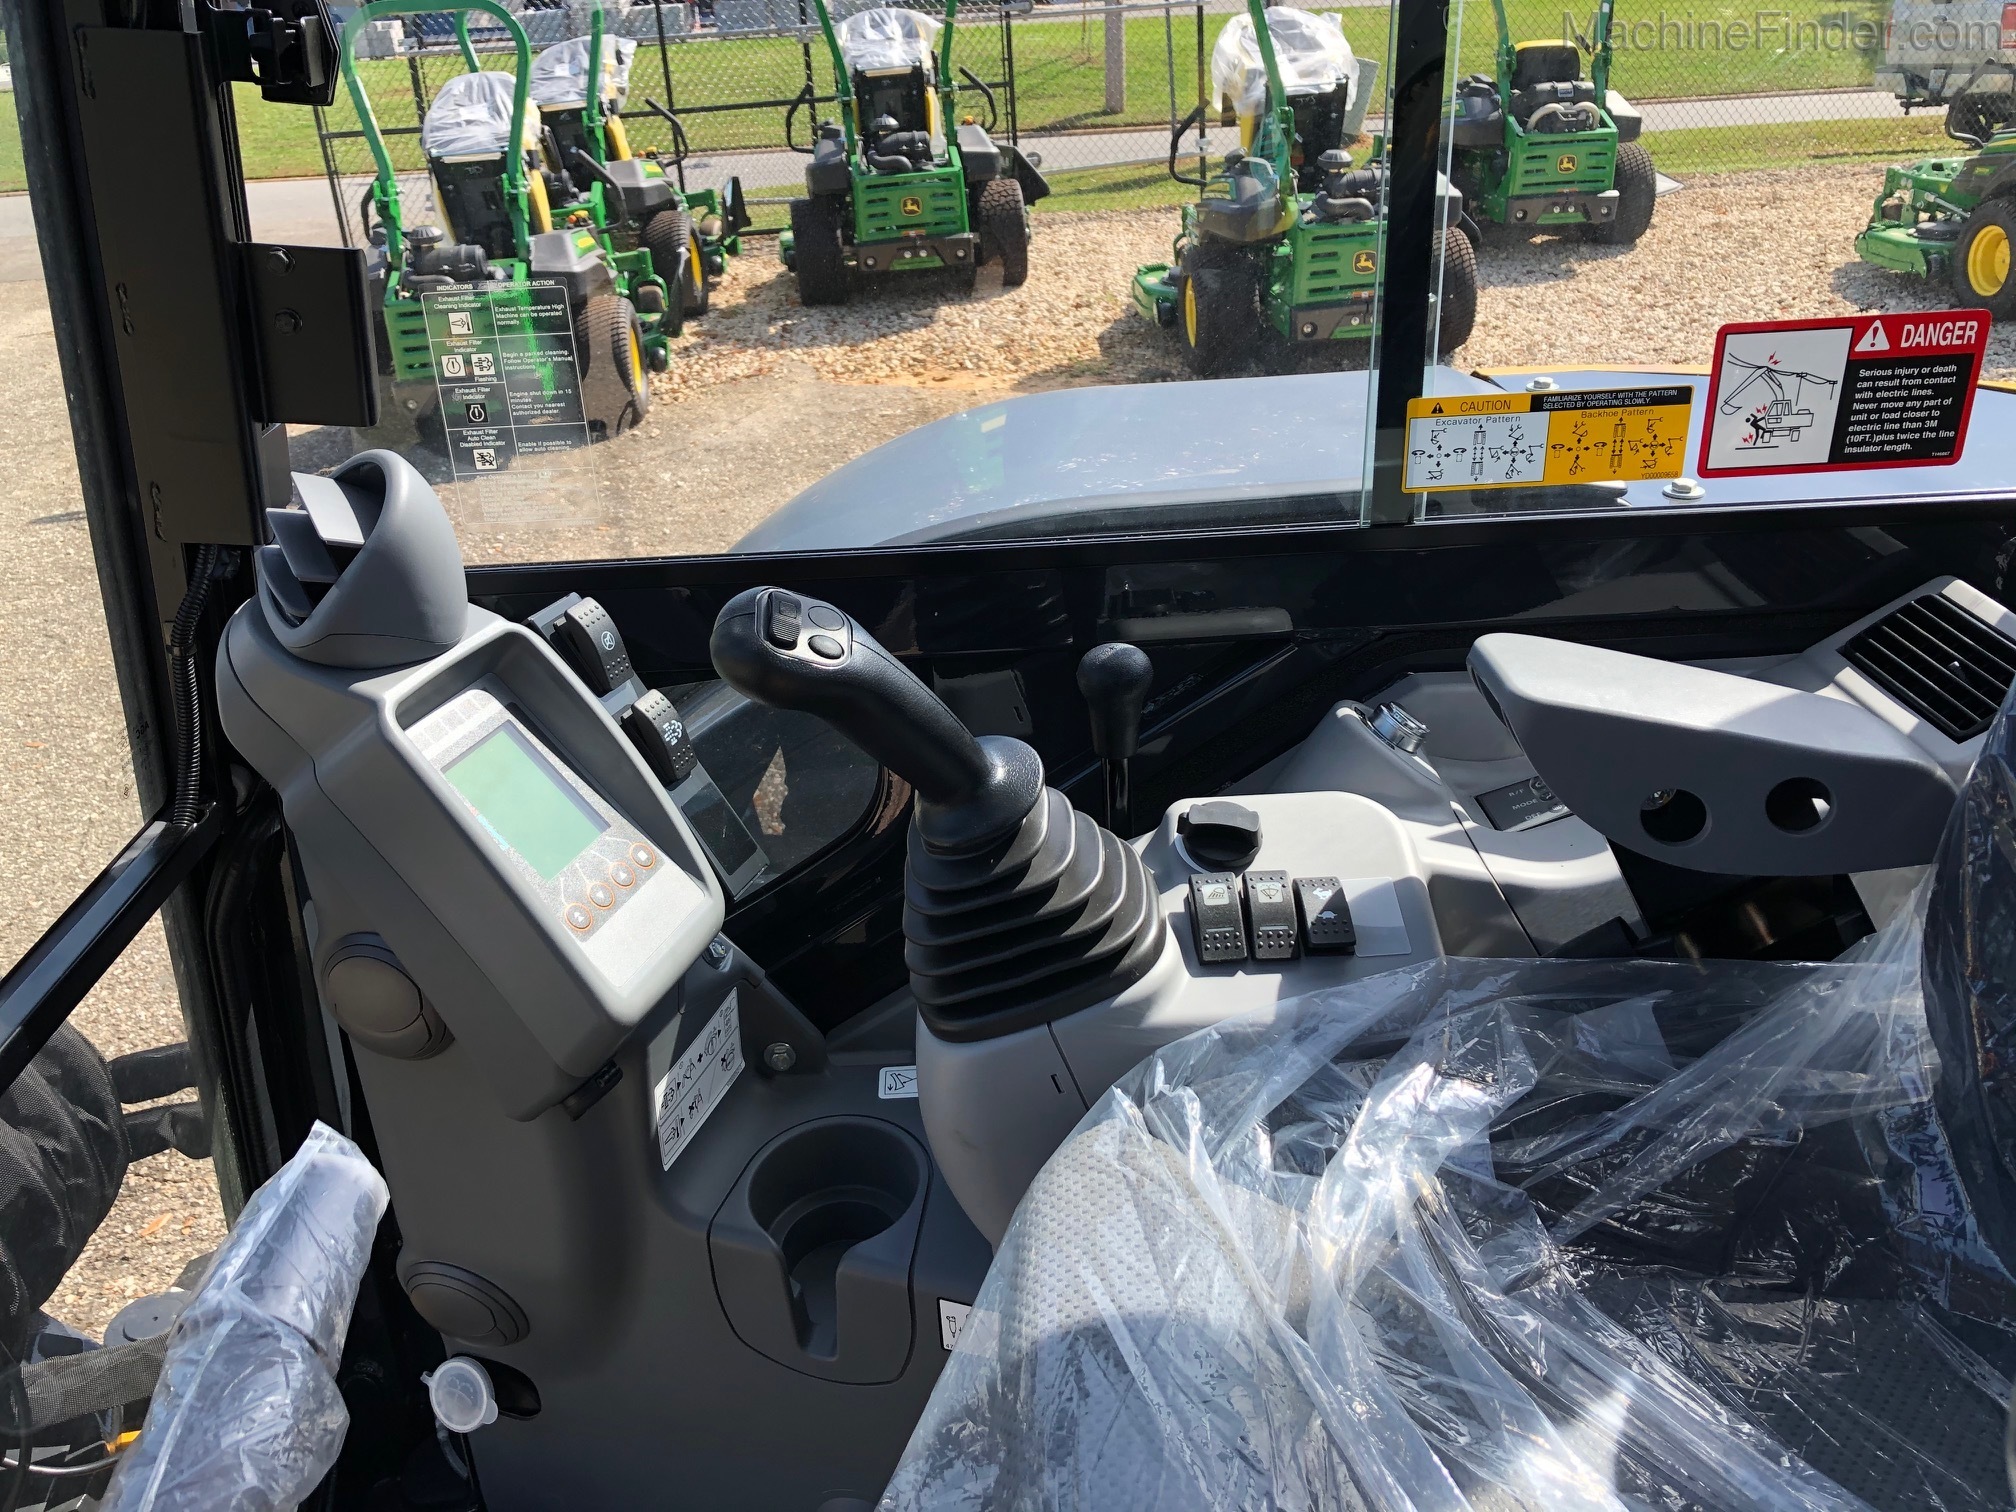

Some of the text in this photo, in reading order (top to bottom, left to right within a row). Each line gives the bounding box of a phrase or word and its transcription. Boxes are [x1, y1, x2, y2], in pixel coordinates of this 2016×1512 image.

[1900, 320, 1978, 348] DANGER
[1859, 368, 1892, 377] Serious
[1894, 366, 1919, 377] injury
[1932, 364, 1957, 373] death
[1875, 378, 1900, 387] result
[1901, 377, 1922, 386] from
[1924, 375, 1957, 385] contact
[1543, 389, 1678, 403] FAMILIARIZE YOURSELF WITH THE PATTERN
[1855, 388, 1934, 399] with electric lines.
[1460, 399, 1511, 412] CAUTION
[1543, 397, 1652, 410] SELECTED BY OPERATING SLOWLY.
[1852, 397, 1953, 410] Never move any part of
[1581, 408, 1654, 419] Backhoe Pattern
[1850, 413, 1868, 421] unit
[1881, 411, 1900, 420] load
[1902, 410, 1929, 418] closer
[1931, 409, 1940, 417] to
[1435, 415, 1521, 427] Excavator Pattern
[1848, 419, 1938, 432] electric line than 3M
[1897, 432, 1920, 440] twice
[1922, 430, 1937, 439] the
[1938, 430, 1955, 438] line
[1844, 443, 1913, 454] insulator length.
[1512, 798, 1538, 810] MODE
